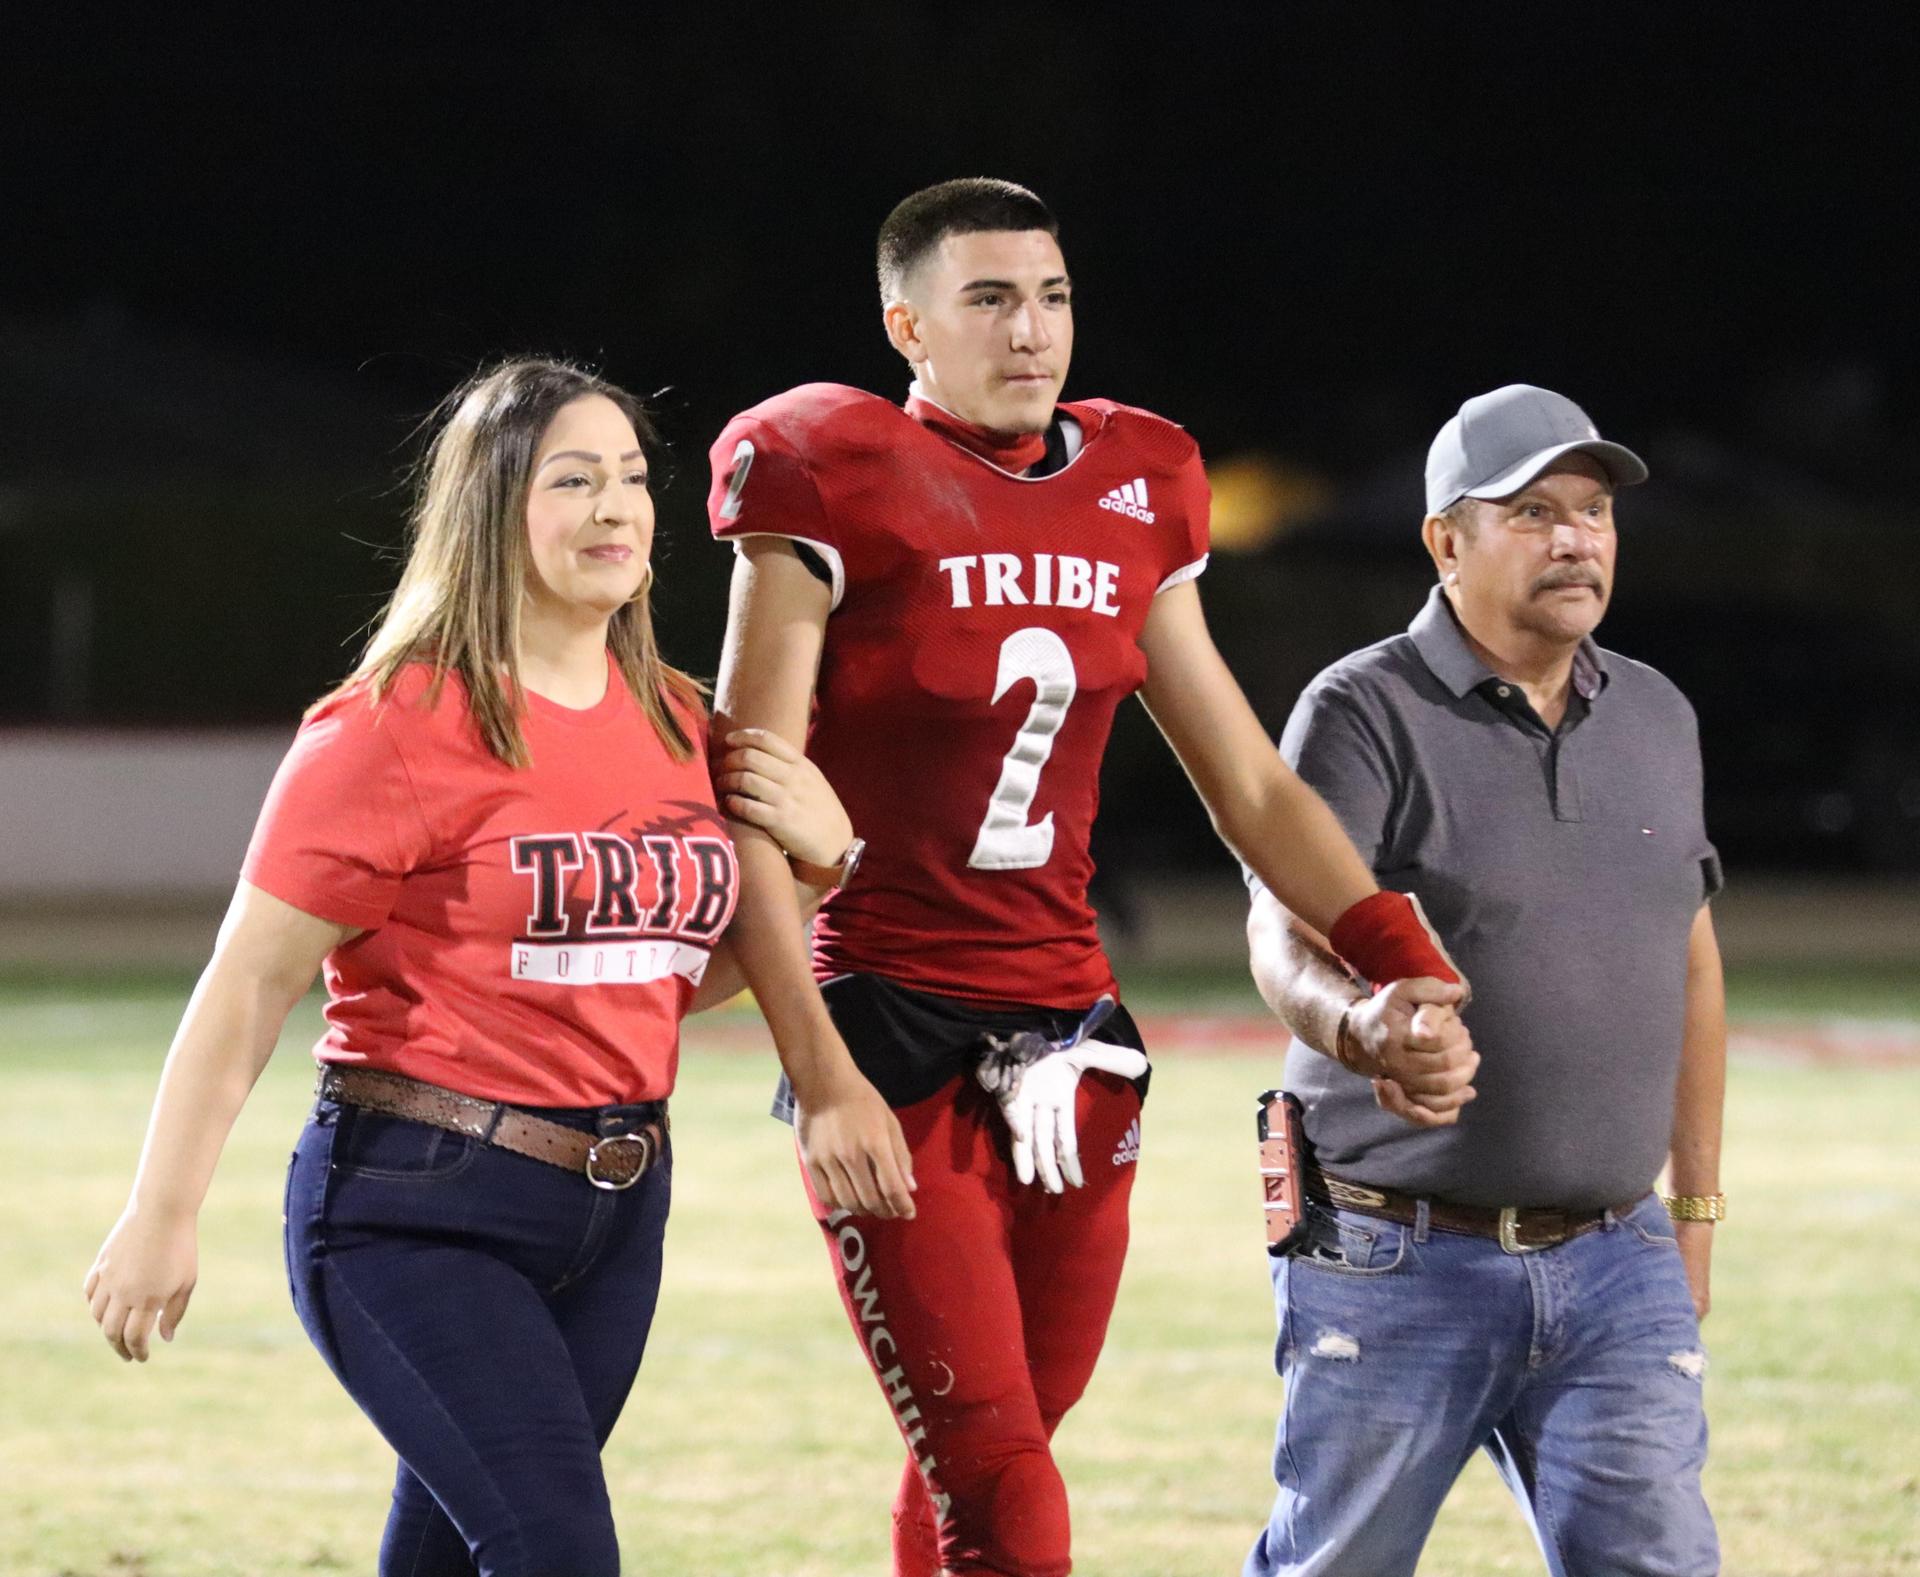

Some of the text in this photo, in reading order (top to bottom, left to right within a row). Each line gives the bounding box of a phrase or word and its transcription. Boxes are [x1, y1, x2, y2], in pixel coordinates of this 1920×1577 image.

[719, 440, 755, 519] 2
[1098, 497, 1156, 525] adidas
[939, 553, 1121, 617] TRIBE
[967, 627, 1077, 871] 2
